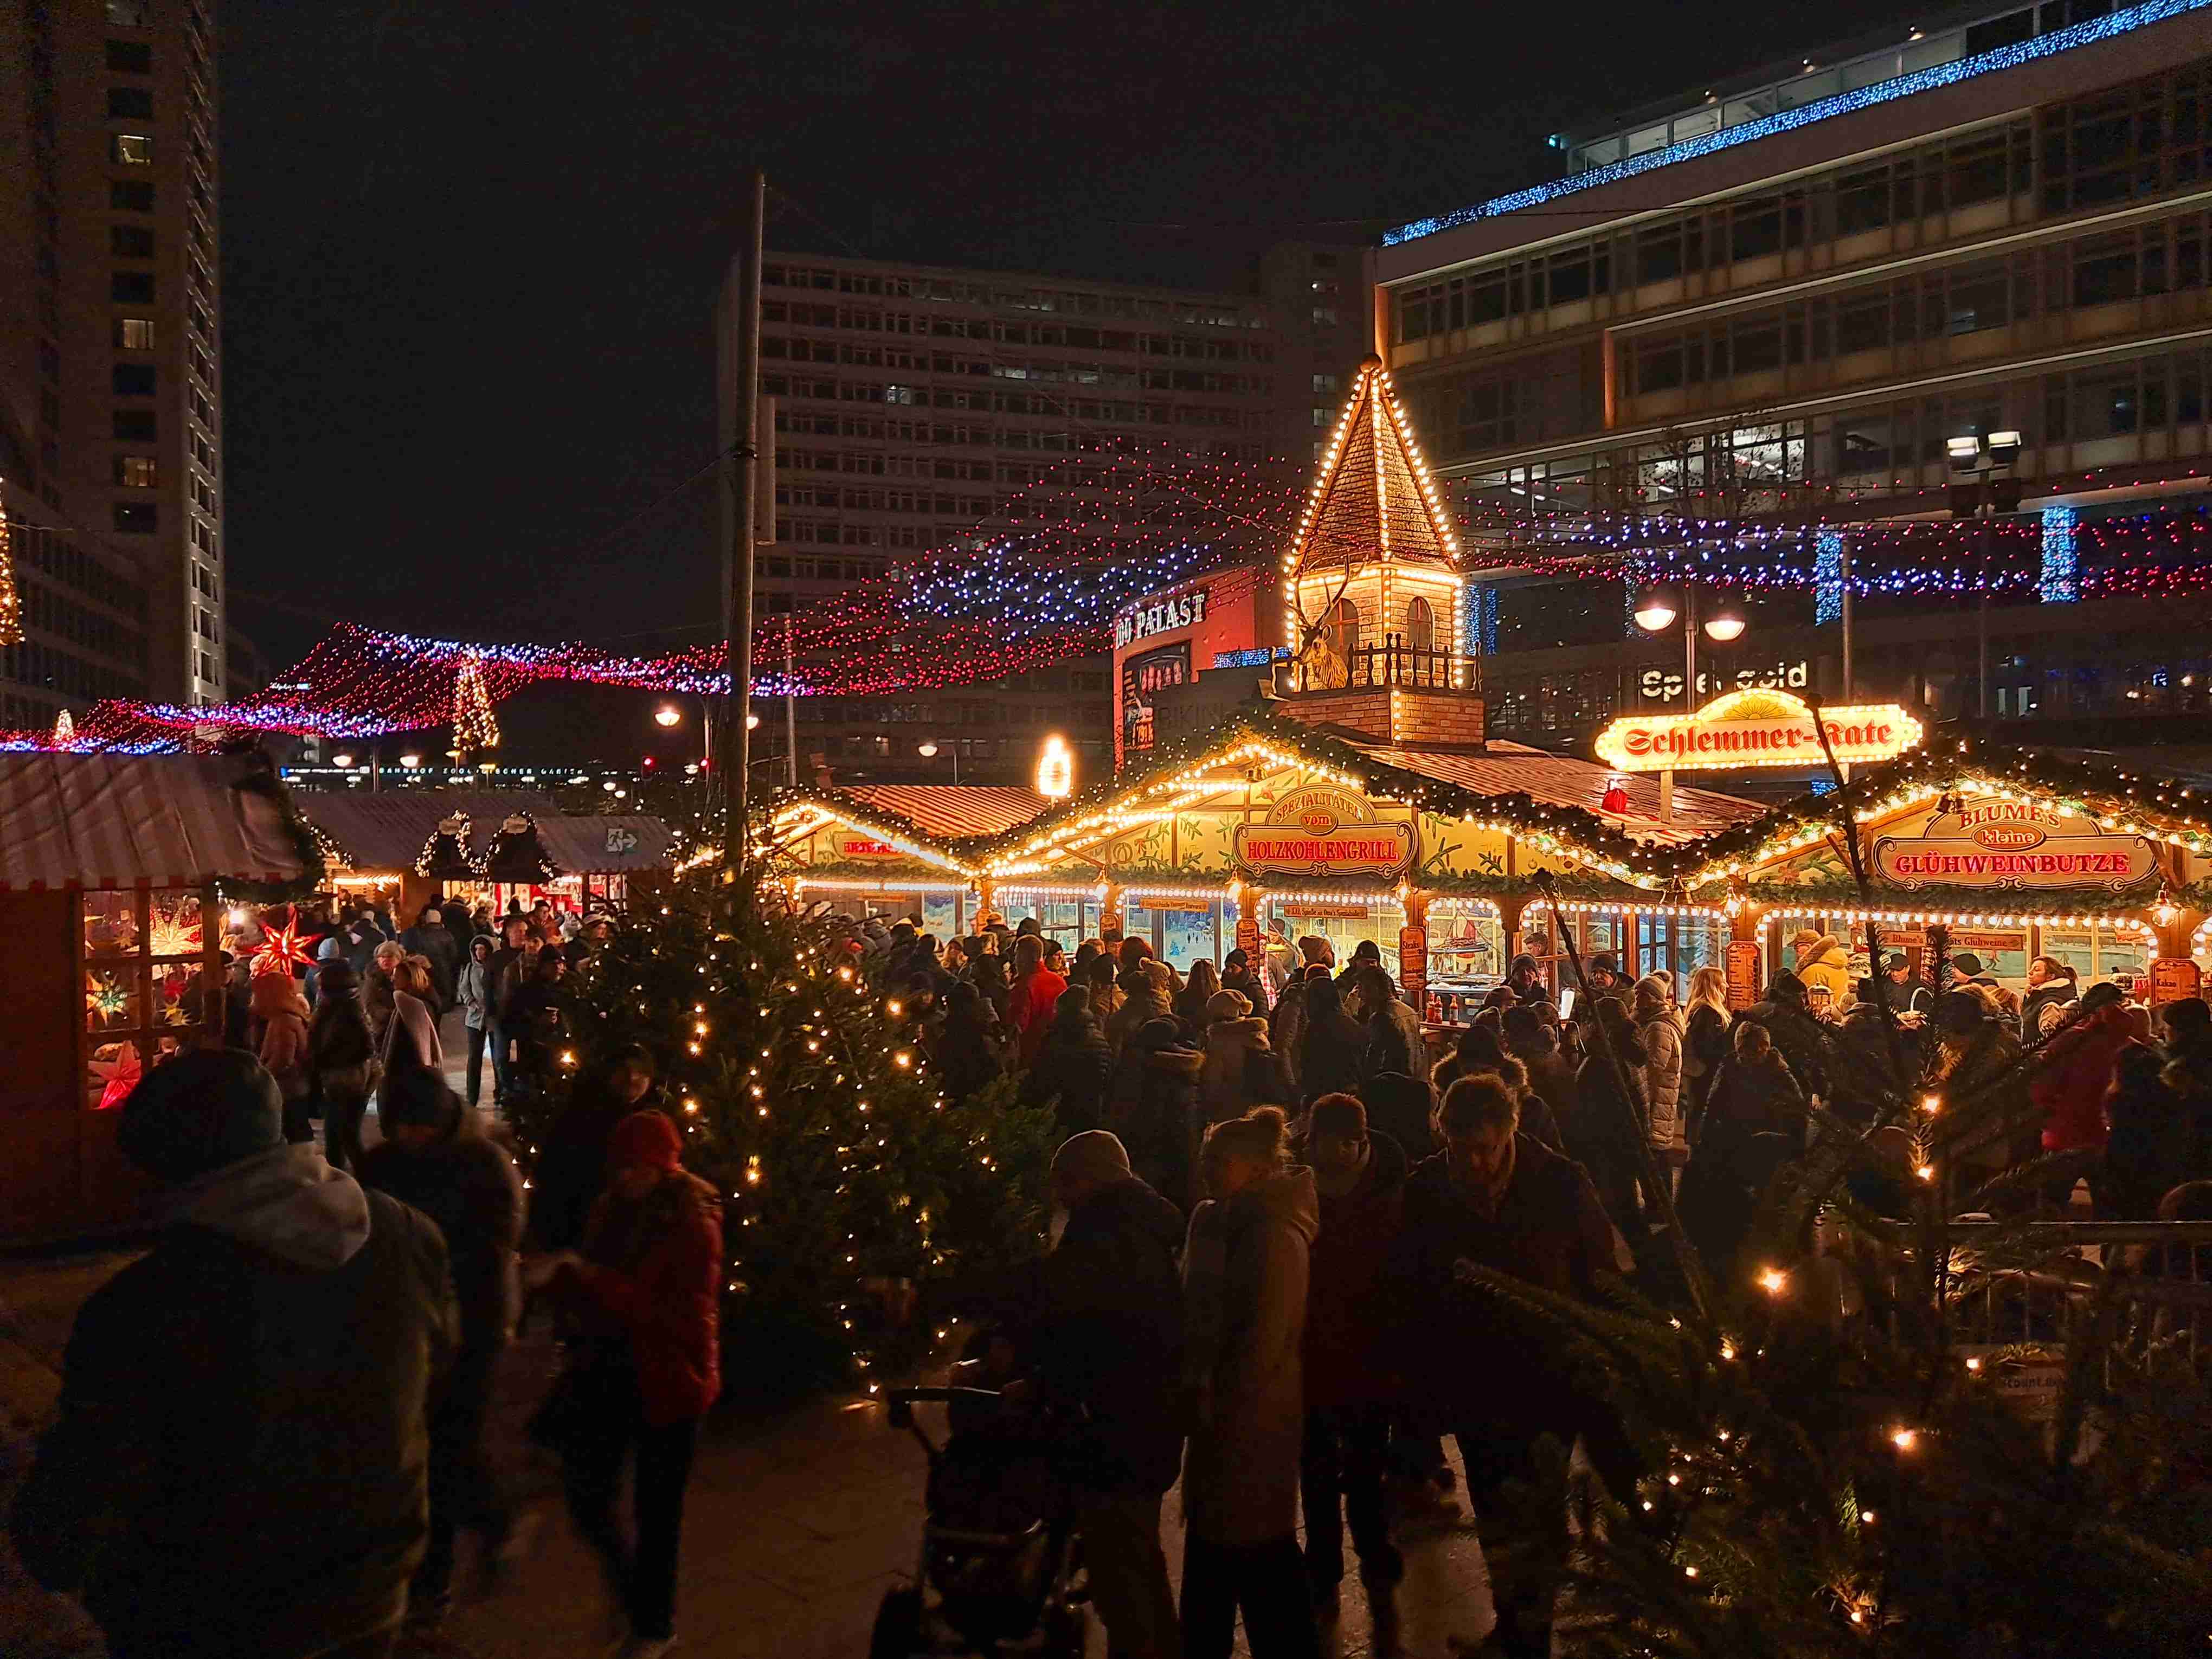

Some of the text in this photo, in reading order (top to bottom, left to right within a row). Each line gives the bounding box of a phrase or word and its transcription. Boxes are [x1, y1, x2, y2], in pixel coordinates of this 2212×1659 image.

[1136, 593, 1205, 639] PALAST
[1623, 720, 1894, 762] Schlemmer-Kate
[1276, 790, 1365, 824] SPEZIALITÄTEN
[1304, 814, 1332, 826] vom
[1981, 830, 2036, 845] kleine
[1248, 840, 1398, 860] HOLZKOHLENGRILL
[1895, 850, 2131, 876] GLÜHWEINBUTZE
[1892, 934, 1924, 943] Blume's
[1964, 936, 2008, 947] Glühweine
